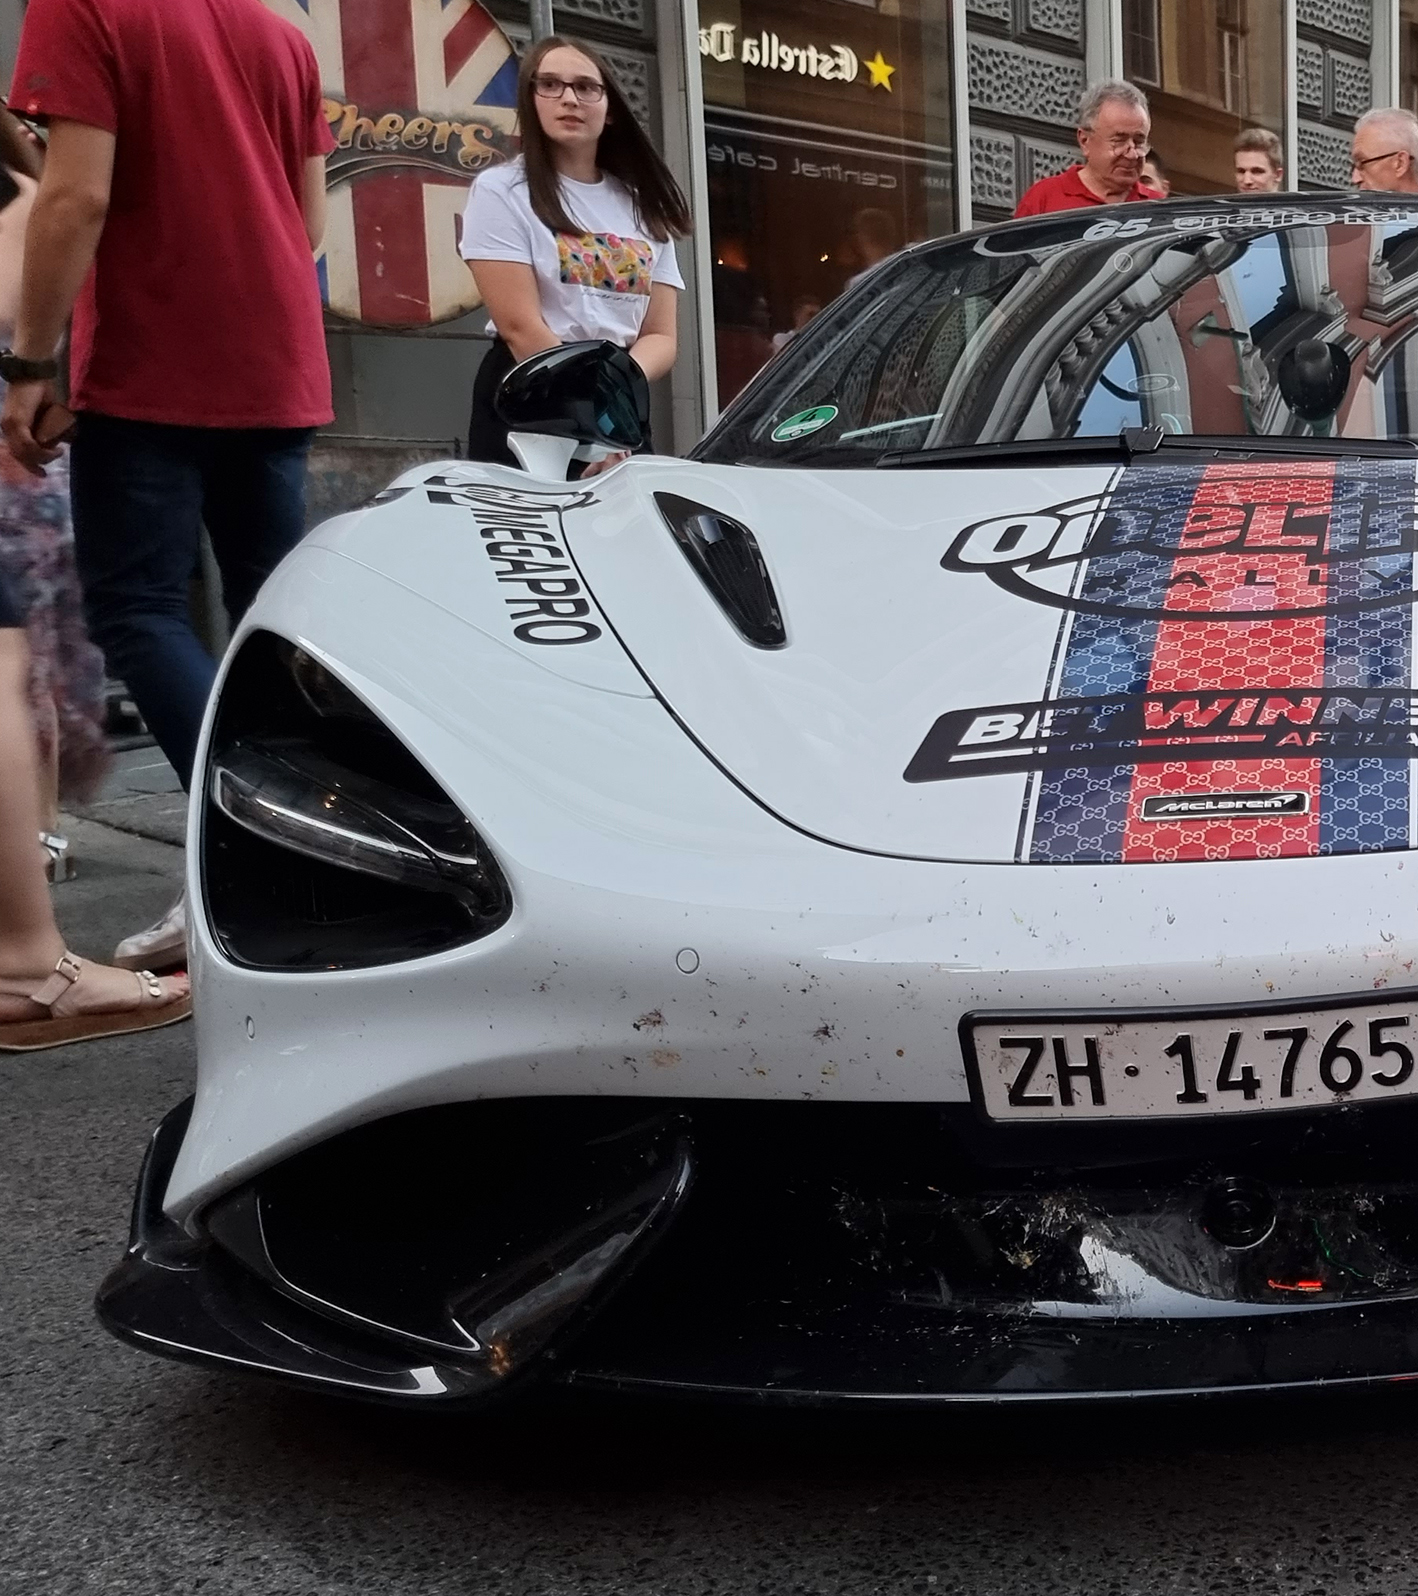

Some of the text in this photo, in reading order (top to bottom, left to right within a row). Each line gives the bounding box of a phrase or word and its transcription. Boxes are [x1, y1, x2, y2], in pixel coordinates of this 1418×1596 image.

[322, 98, 507, 170] heers
[1083, 217, 1152, 242] 65
[470, 507, 602, 646] MEGAPRO
[999, 1015, 1416, 1107] ZH 14765
